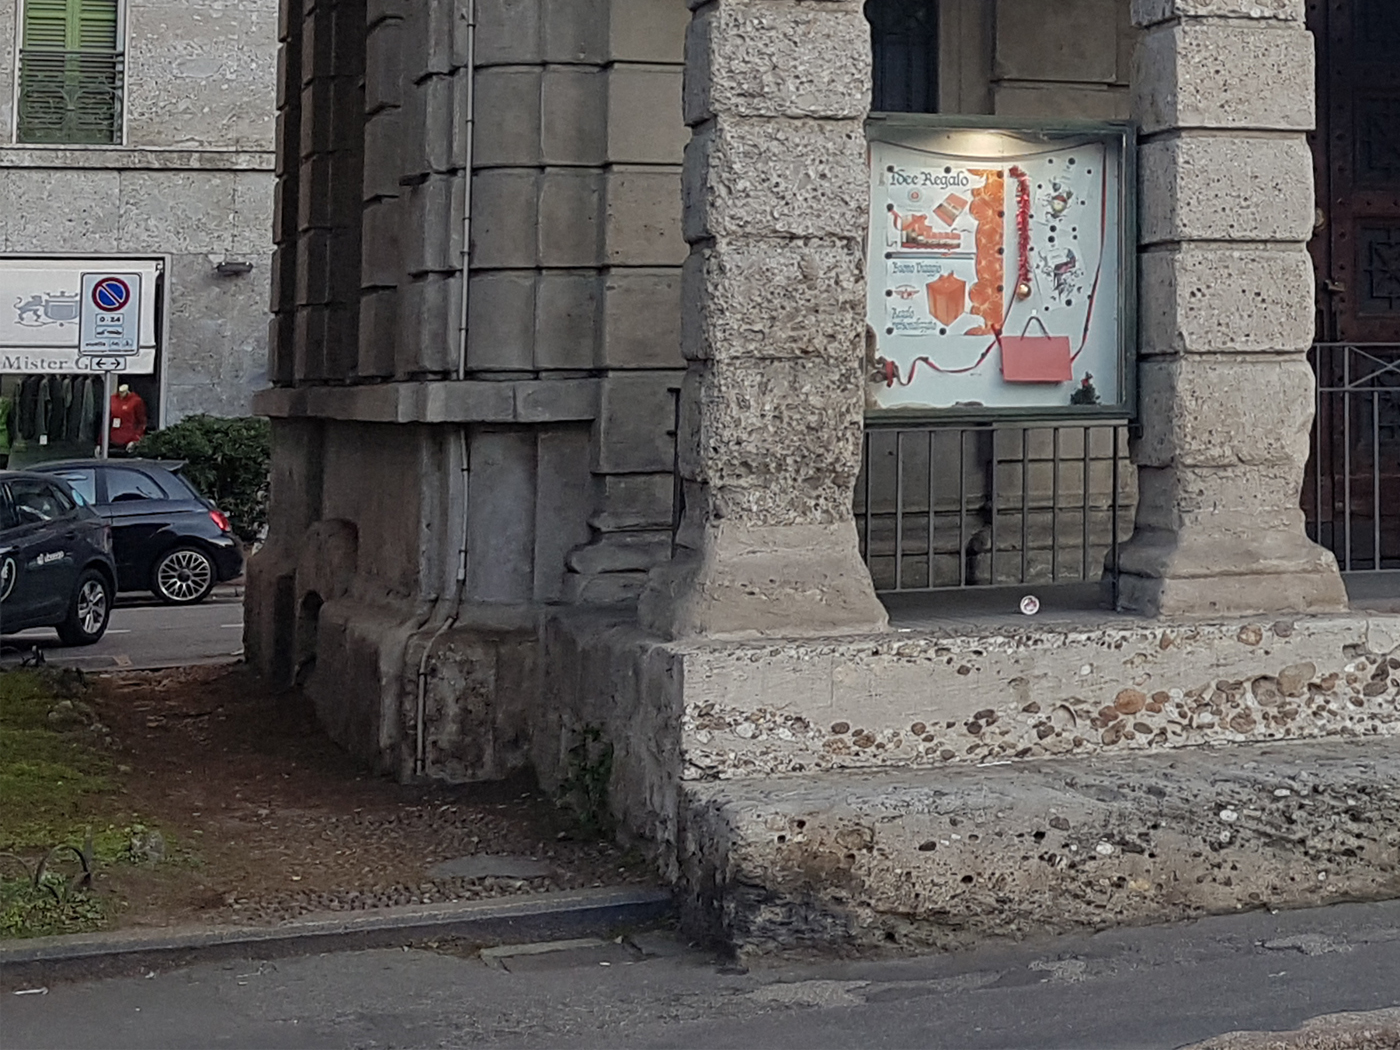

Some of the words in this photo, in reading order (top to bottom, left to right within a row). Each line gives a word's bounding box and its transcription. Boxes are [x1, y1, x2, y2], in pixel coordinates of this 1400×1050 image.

[920, 171, 969, 190] Regalo
[3, 356, 68, 370] Mister
[75, 356, 88, 370] G
